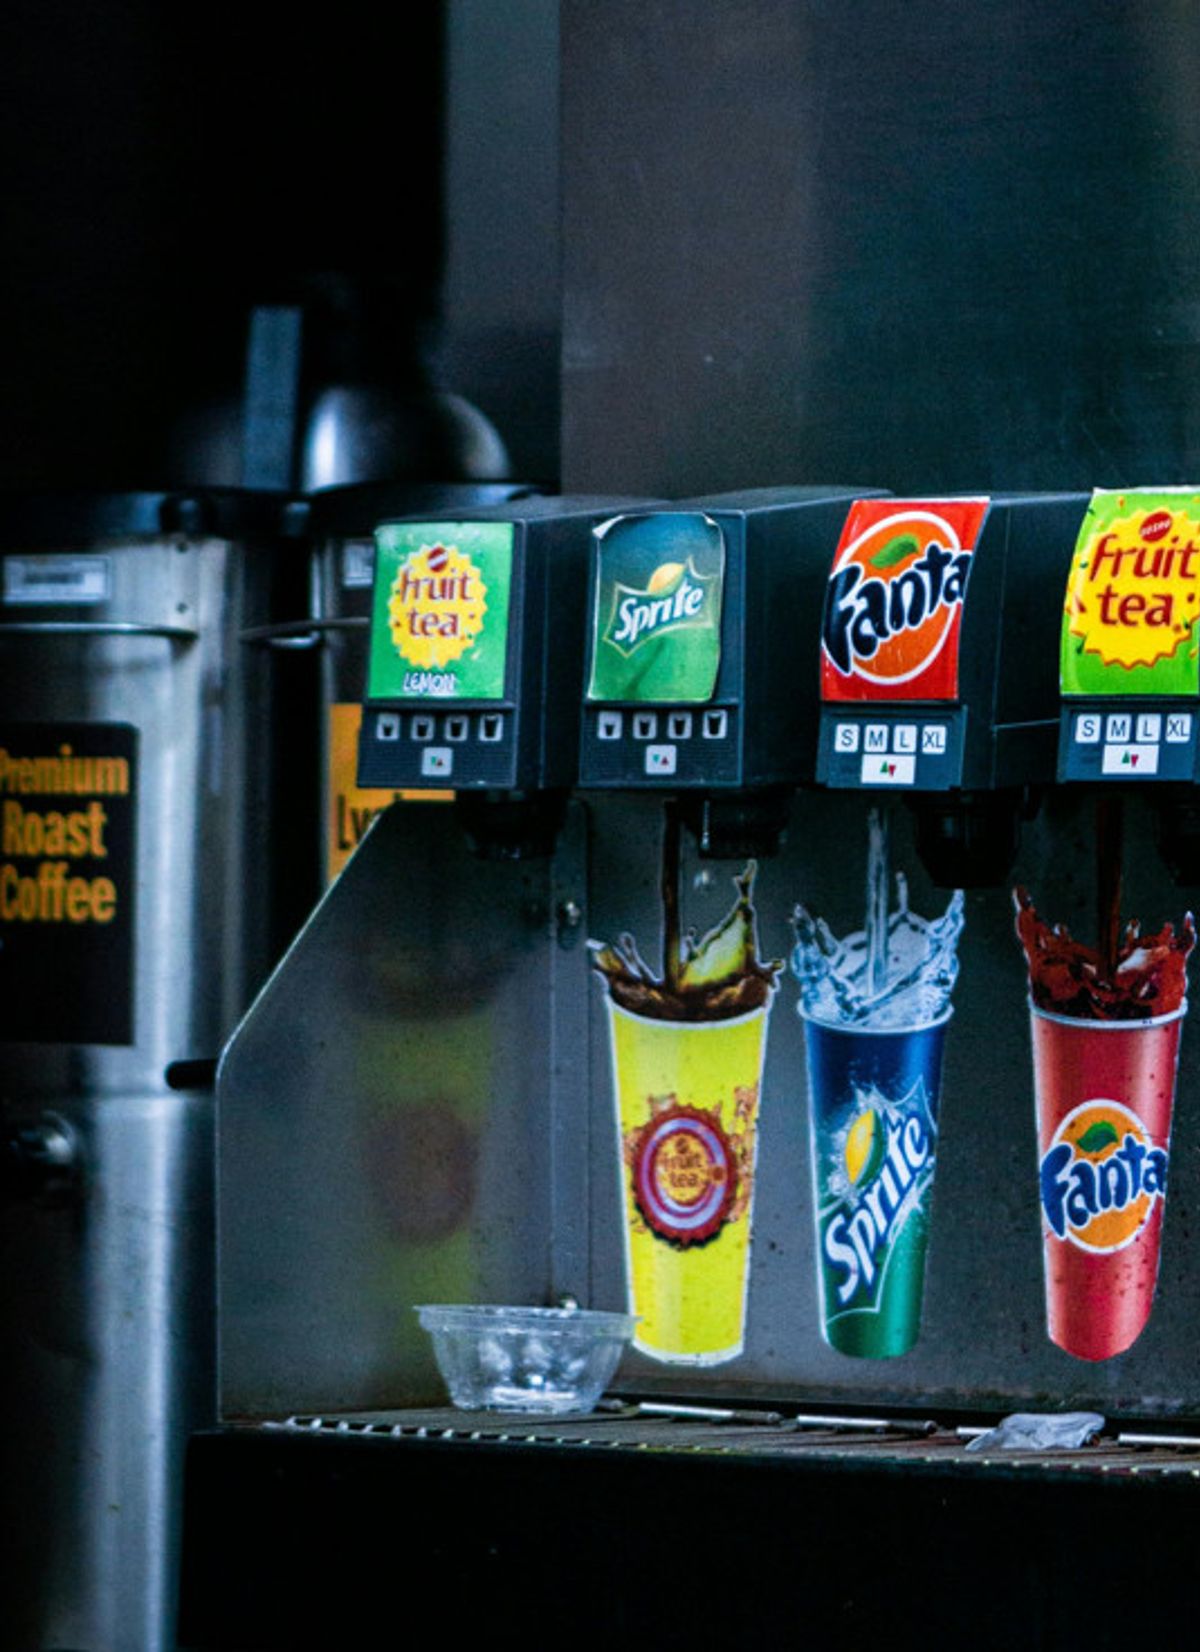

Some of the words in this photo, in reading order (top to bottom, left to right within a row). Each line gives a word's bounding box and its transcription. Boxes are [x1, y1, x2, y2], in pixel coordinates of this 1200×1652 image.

[1089, 534, 1200, 583] fruit
[400, 567, 473, 605] fruit
[614, 580, 703, 642] Sprite
[822, 542, 974, 676] Fanta
[1096, 585, 1173, 628] tea
[406, 607, 459, 637] tea
[841, 729, 854, 747] S
[869, 730, 884, 748] M
[899, 730, 911, 747] L
[924, 730, 945, 748] XL
[1082, 720, 1095, 737] S
[1111, 719, 1127, 737] M
[1142, 719, 1152, 736] L
[1168, 718, 1190, 736] XL
[4, 802, 107, 856] Roast
[0, 863, 116, 922] Coffee
[824, 1110, 928, 1303] Sprite
[1040, 1137, 1166, 1238] Fanta
